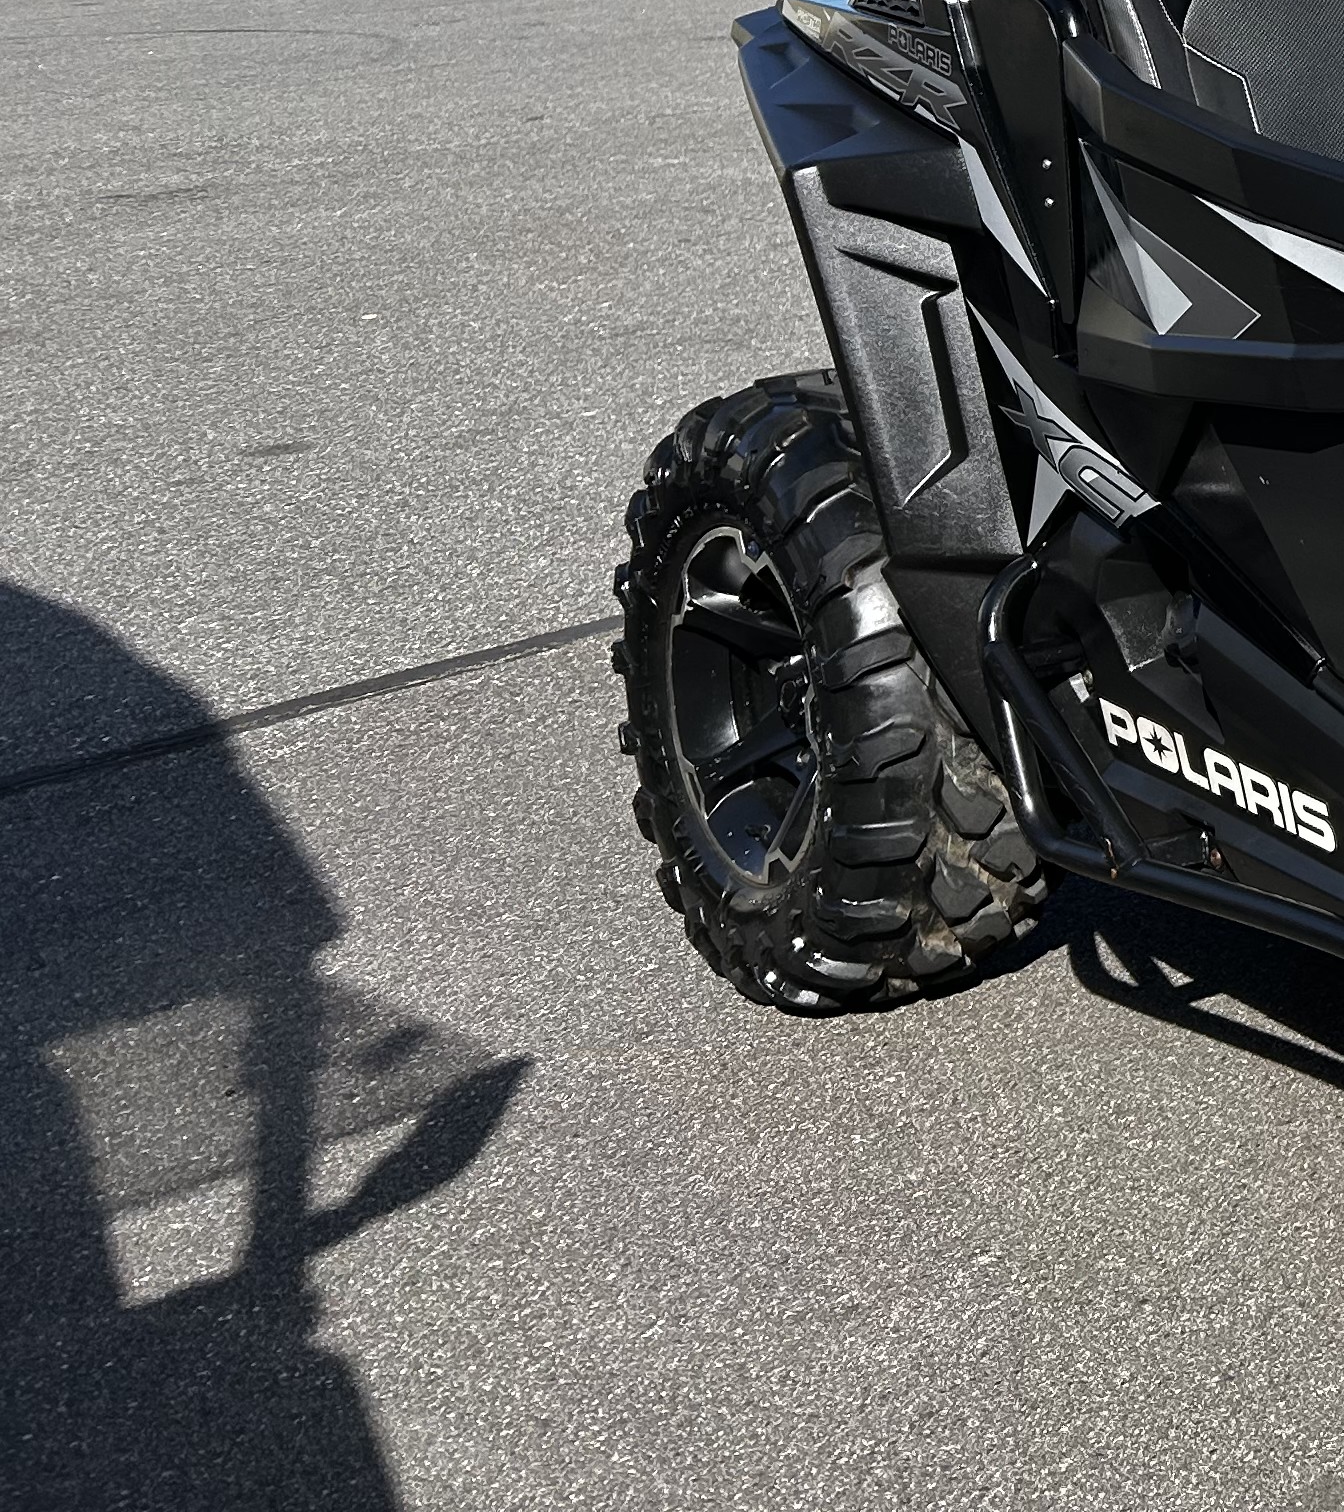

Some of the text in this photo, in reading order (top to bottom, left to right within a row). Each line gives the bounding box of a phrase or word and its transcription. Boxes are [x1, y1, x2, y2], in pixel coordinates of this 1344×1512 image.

[822, 11, 968, 131] RZR
[887, 23, 952, 77] POLARIS
[998, 377, 1148, 524] XC
[1099, 697, 1337, 853] POLARIS
